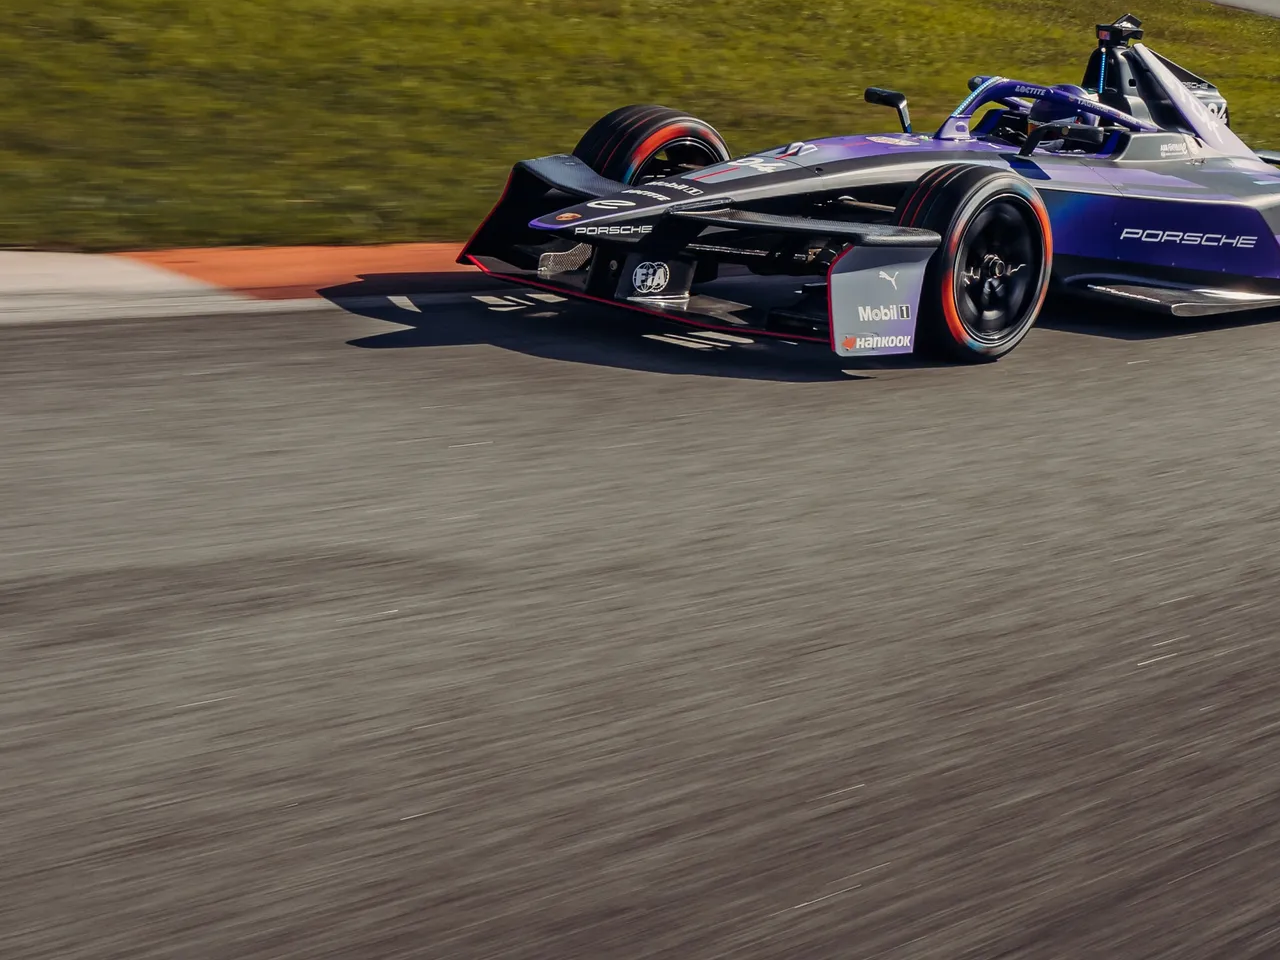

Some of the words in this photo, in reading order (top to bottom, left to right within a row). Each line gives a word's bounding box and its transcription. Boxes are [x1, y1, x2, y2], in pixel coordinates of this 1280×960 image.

[1015, 85, 1046, 96] LOCTITE
[644, 180, 689, 191] Mobil
[574, 225, 653, 235] PORSCHE
[1120, 228, 1258, 248] PORSCHE
[858, 304, 897, 321] Mobil
